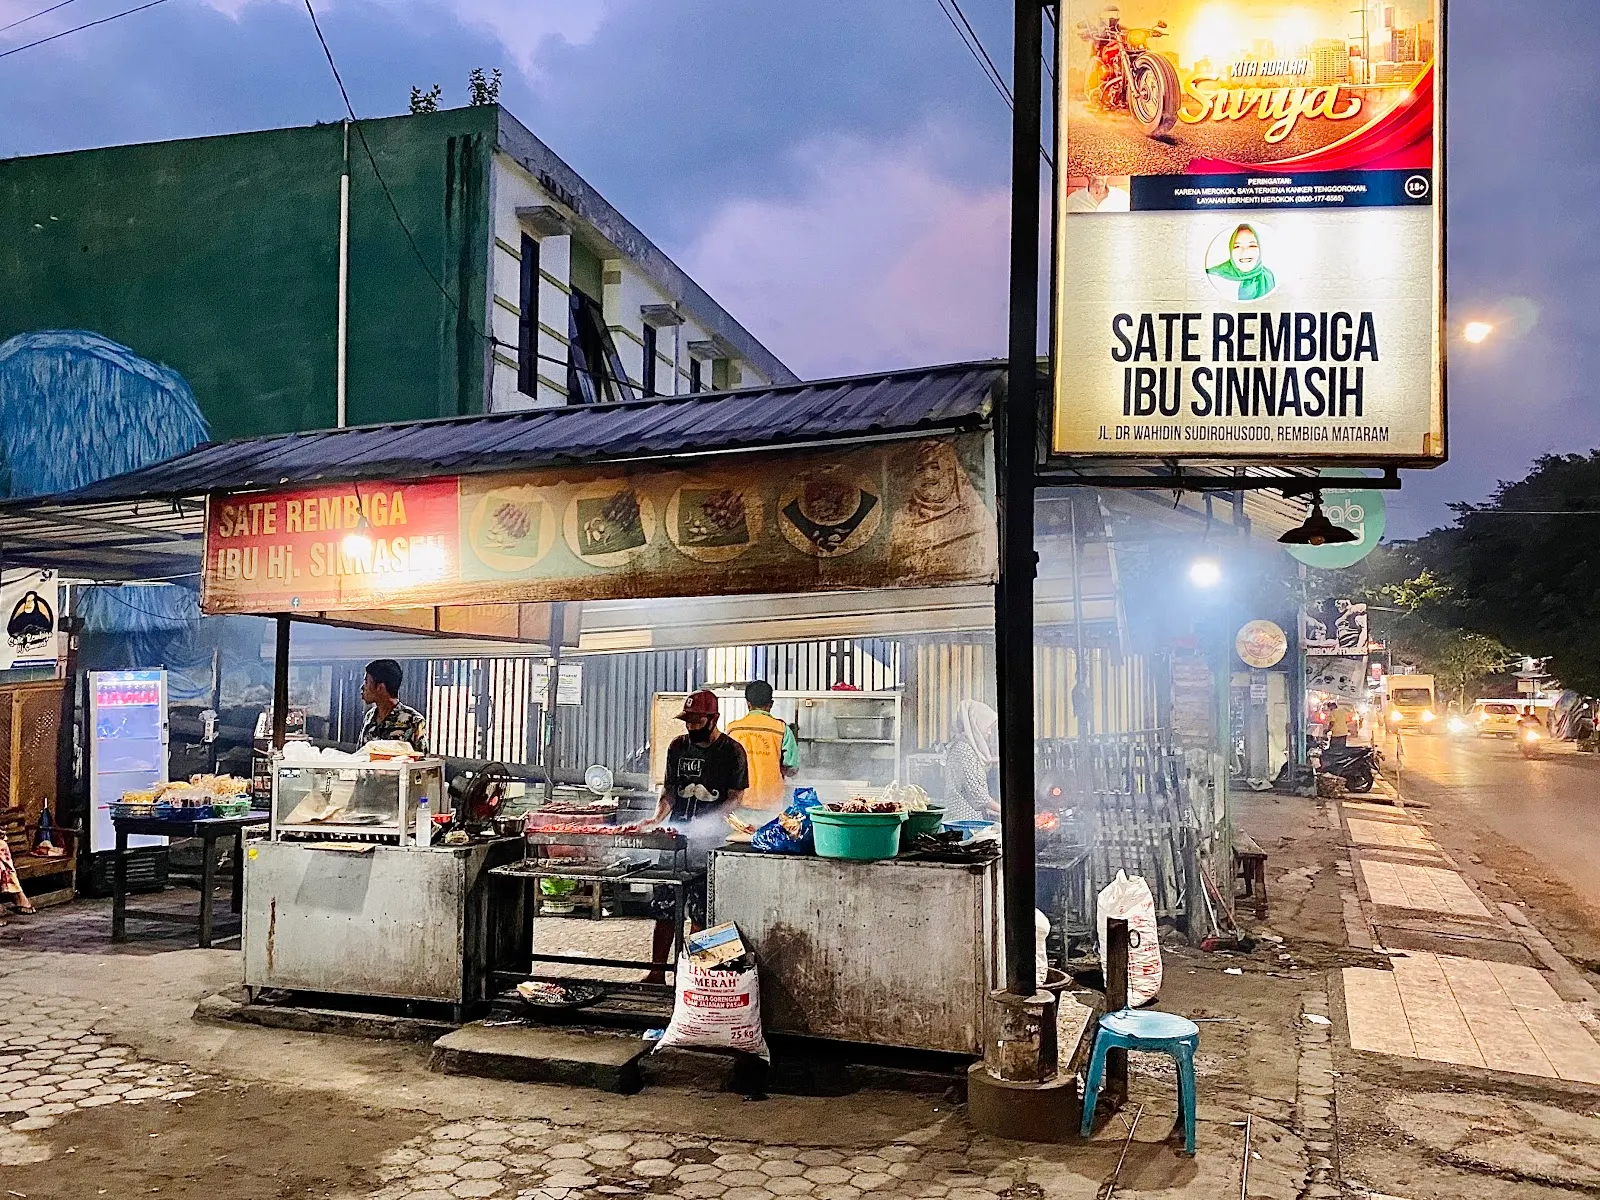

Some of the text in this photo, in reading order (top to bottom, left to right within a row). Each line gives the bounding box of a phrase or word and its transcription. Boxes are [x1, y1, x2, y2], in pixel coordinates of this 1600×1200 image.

[1231, 60, 1308, 77] KITA ADALAH
[1177, 72, 1362, 143] Surya
[1174, 188, 1201, 196] KARENA
[1202, 188, 1236, 196] MEROKOK,
[1237, 187, 1254, 195] SAYA
[1254, 186, 1286, 194] TERKENA
[1286, 186, 1313, 194] KANKER
[1408, 182, 1425, 191] 18+
[1227, 196, 1260, 204] BERHENTI
[1111, 311, 1379, 362] SATE REMBIGA
[1123, 366, 1364, 417] IBU SINNASIH
[1098, 425, 1389, 442] JL. DR WAHIDIN SUDIROHUSODO, REMBIGA MATARAM
[219, 491, 408, 538] SATE REMBIGA
[1321, 498, 1364, 523] rab
[217, 546, 259, 580] IBU
[267, 544, 300, 586] Hj.
[680, 760, 701, 772] MG!
[689, 964, 737, 977] LENCAN
[695, 977, 737, 988] MERAH
[731, 1029, 754, 1039] 25 kg
